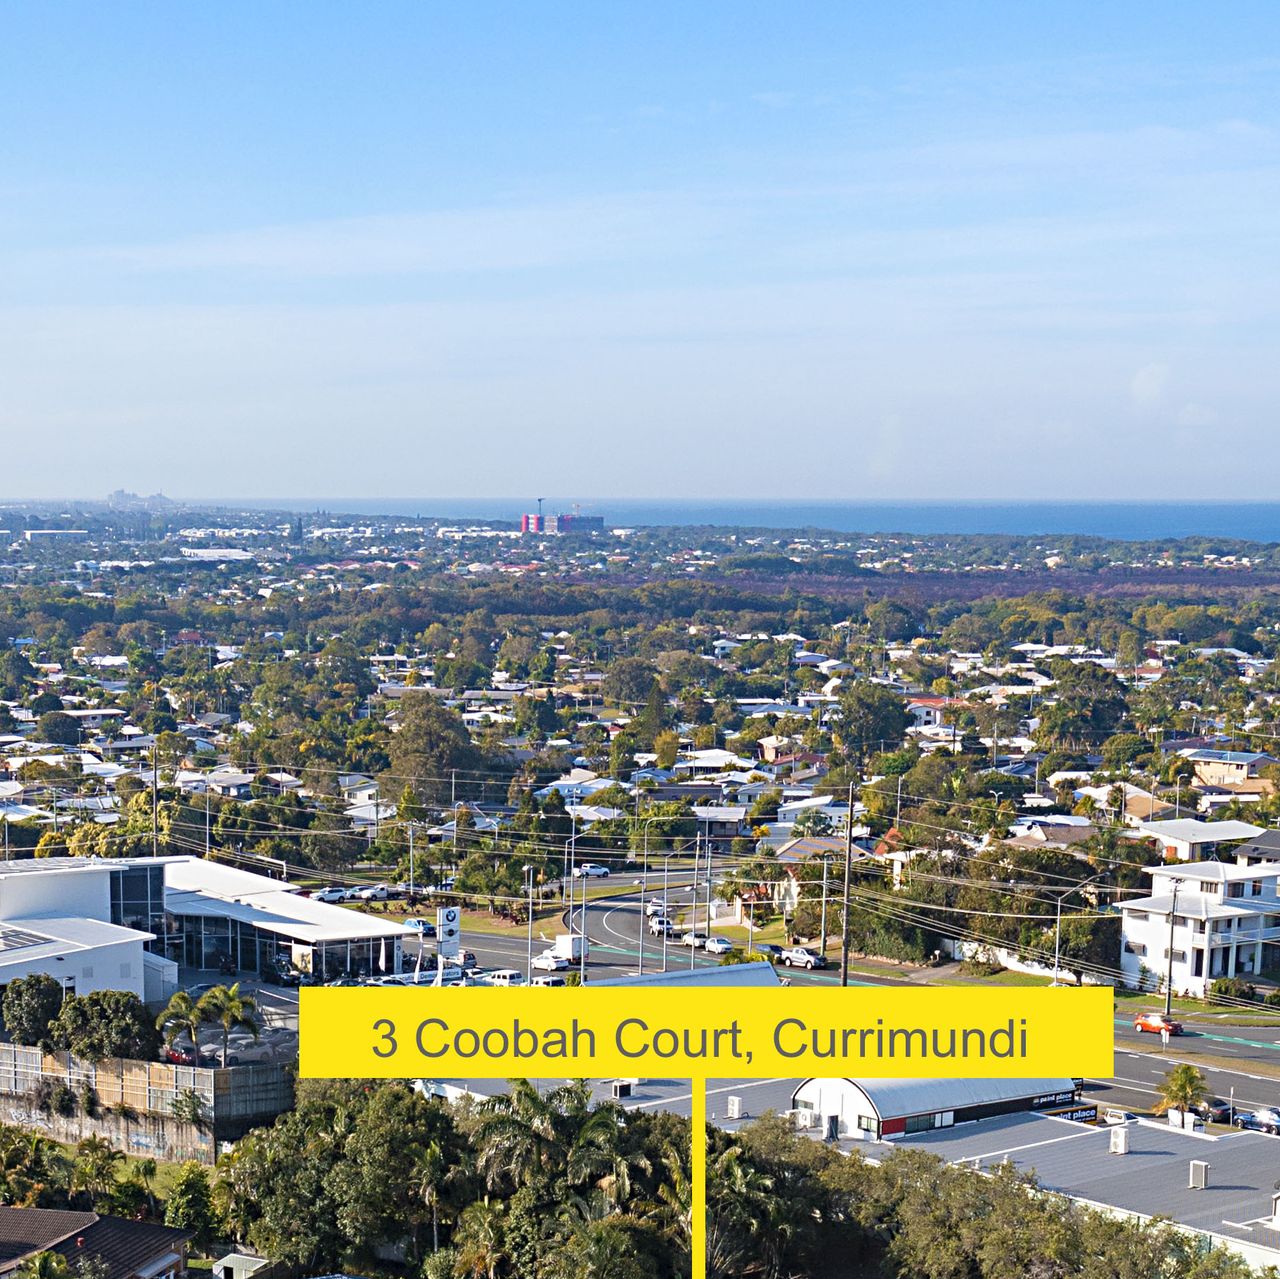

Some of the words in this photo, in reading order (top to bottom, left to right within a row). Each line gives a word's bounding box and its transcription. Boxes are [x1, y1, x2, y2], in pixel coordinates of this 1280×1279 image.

[1040, 1095, 1055, 1103] paint
[1056, 1093, 1072, 1101] place
[1073, 1109, 1096, 1118] place
